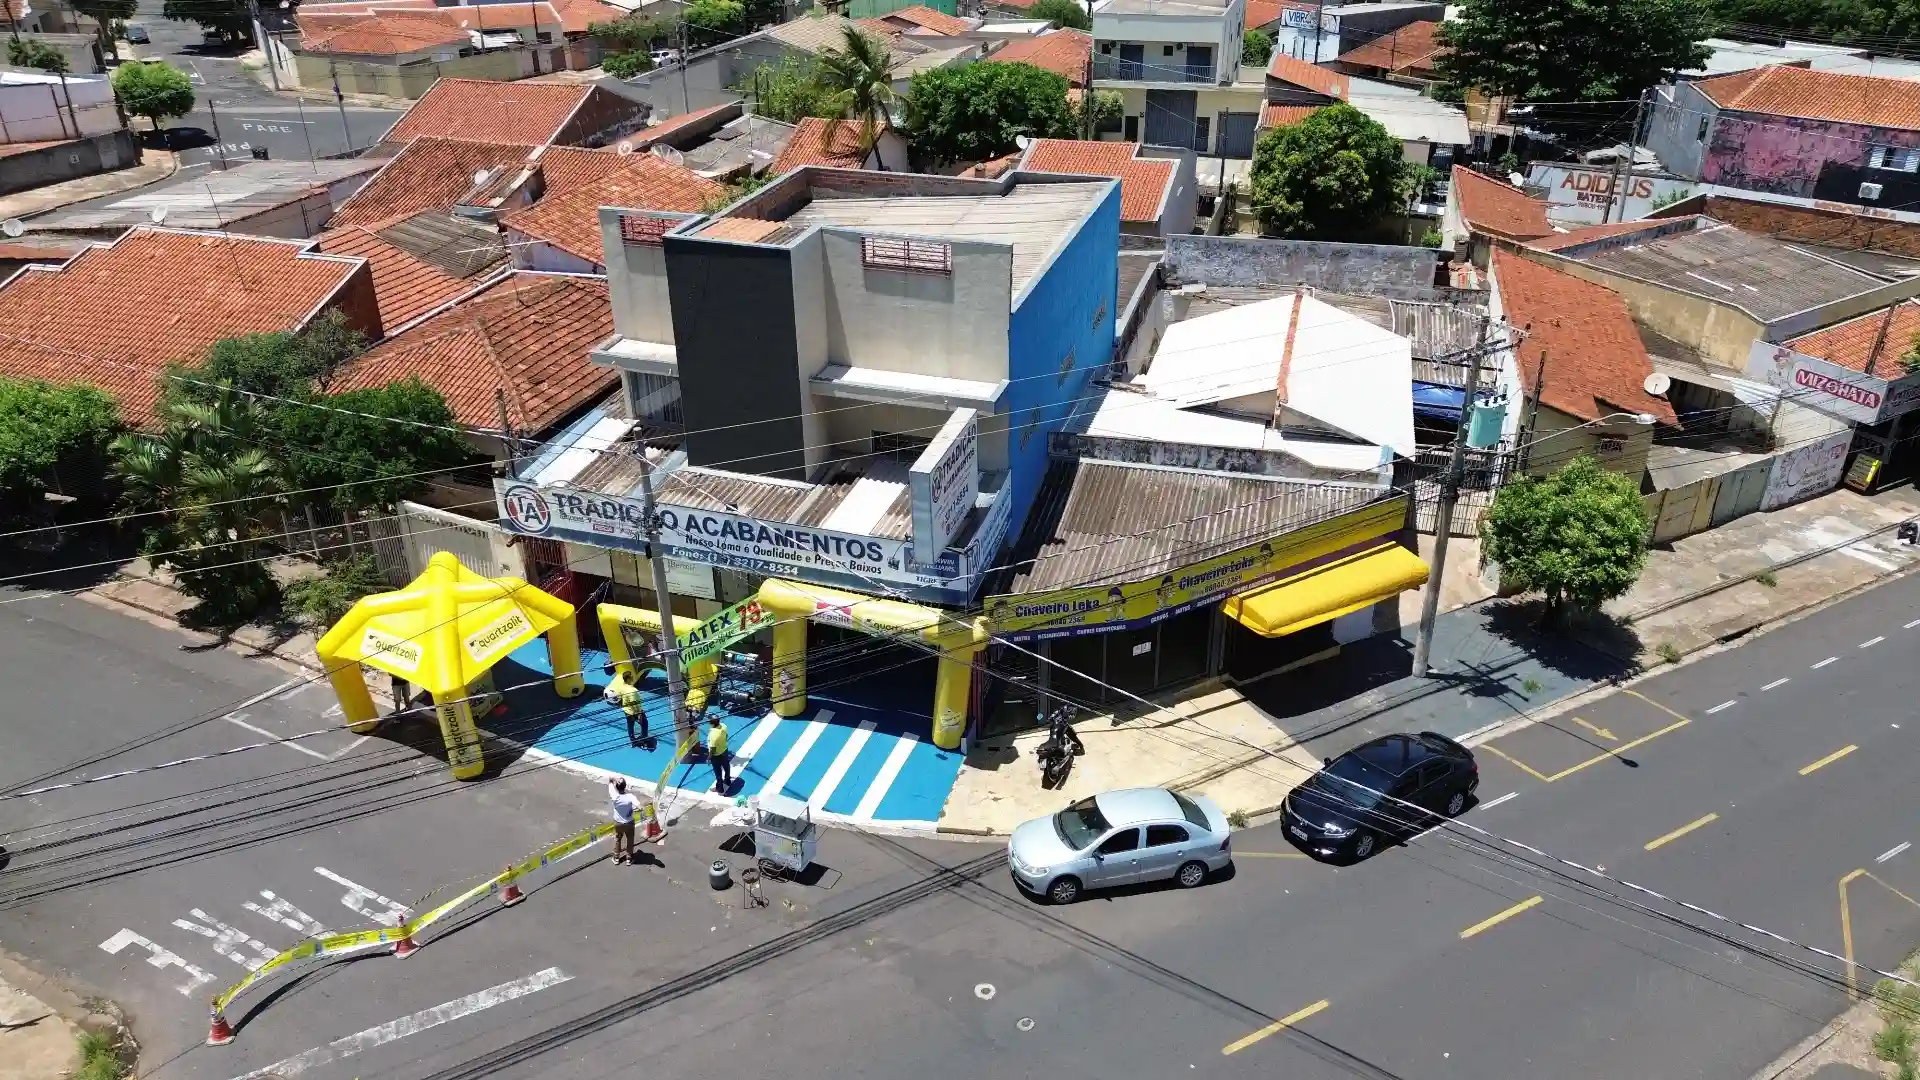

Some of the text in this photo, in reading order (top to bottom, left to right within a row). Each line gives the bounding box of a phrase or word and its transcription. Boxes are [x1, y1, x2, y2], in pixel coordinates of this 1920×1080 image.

[242, 123, 292, 133] PARE
[202, 141, 251, 156] PARE
[1560, 171, 1655, 199] ADIDEUS
[1797, 370, 1877, 408] MIZOHATA
[552, 492, 883, 562] TRADIÇO ACABAMENTOS
[753, 545, 802, 562] Qualidade
[805, 556, 812, 564] e
[849, 560, 882, 575] Baixos
[479, 615, 523, 648] quartzolit
[677, 611, 732, 649] LÁTEX
[375, 639, 419, 663] quartzolit
[679, 642, 715, 665] Village
